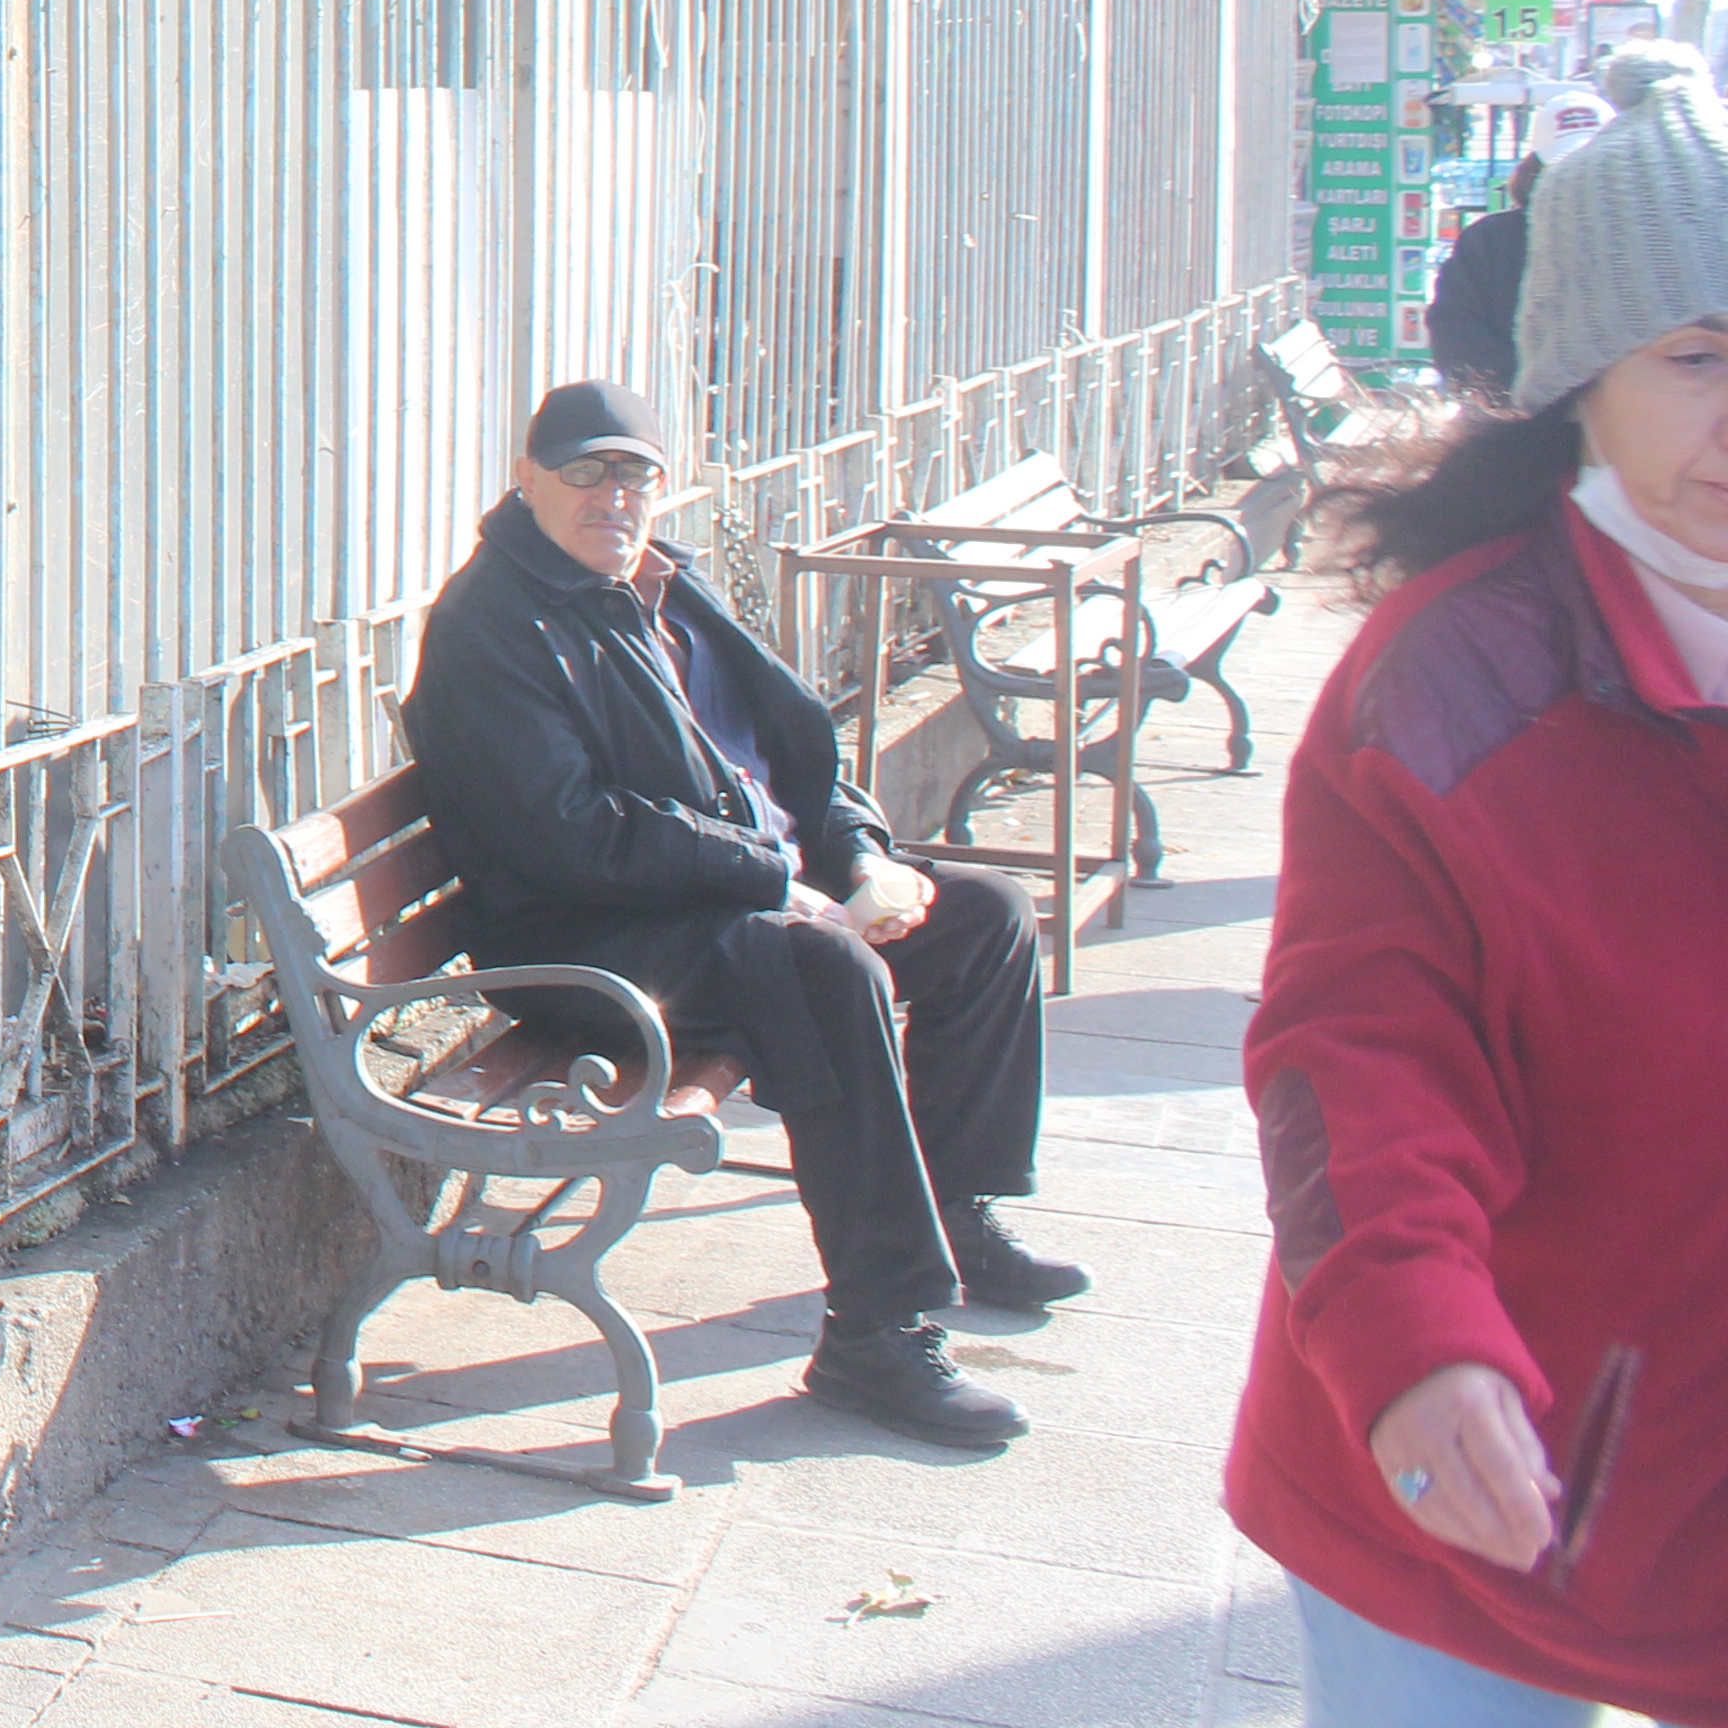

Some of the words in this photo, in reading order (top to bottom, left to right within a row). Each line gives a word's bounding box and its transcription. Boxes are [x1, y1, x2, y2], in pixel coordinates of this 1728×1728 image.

[1493, 8, 1538, 39] 1.5
[1321, 160, 1382, 176] ARAMA
[1326, 217, 1377, 236] ŞARJ
[1325, 242, 1379, 261] ALETİ
[1326, 328, 1350, 346] SU
[1355, 328, 1379, 347] VE
